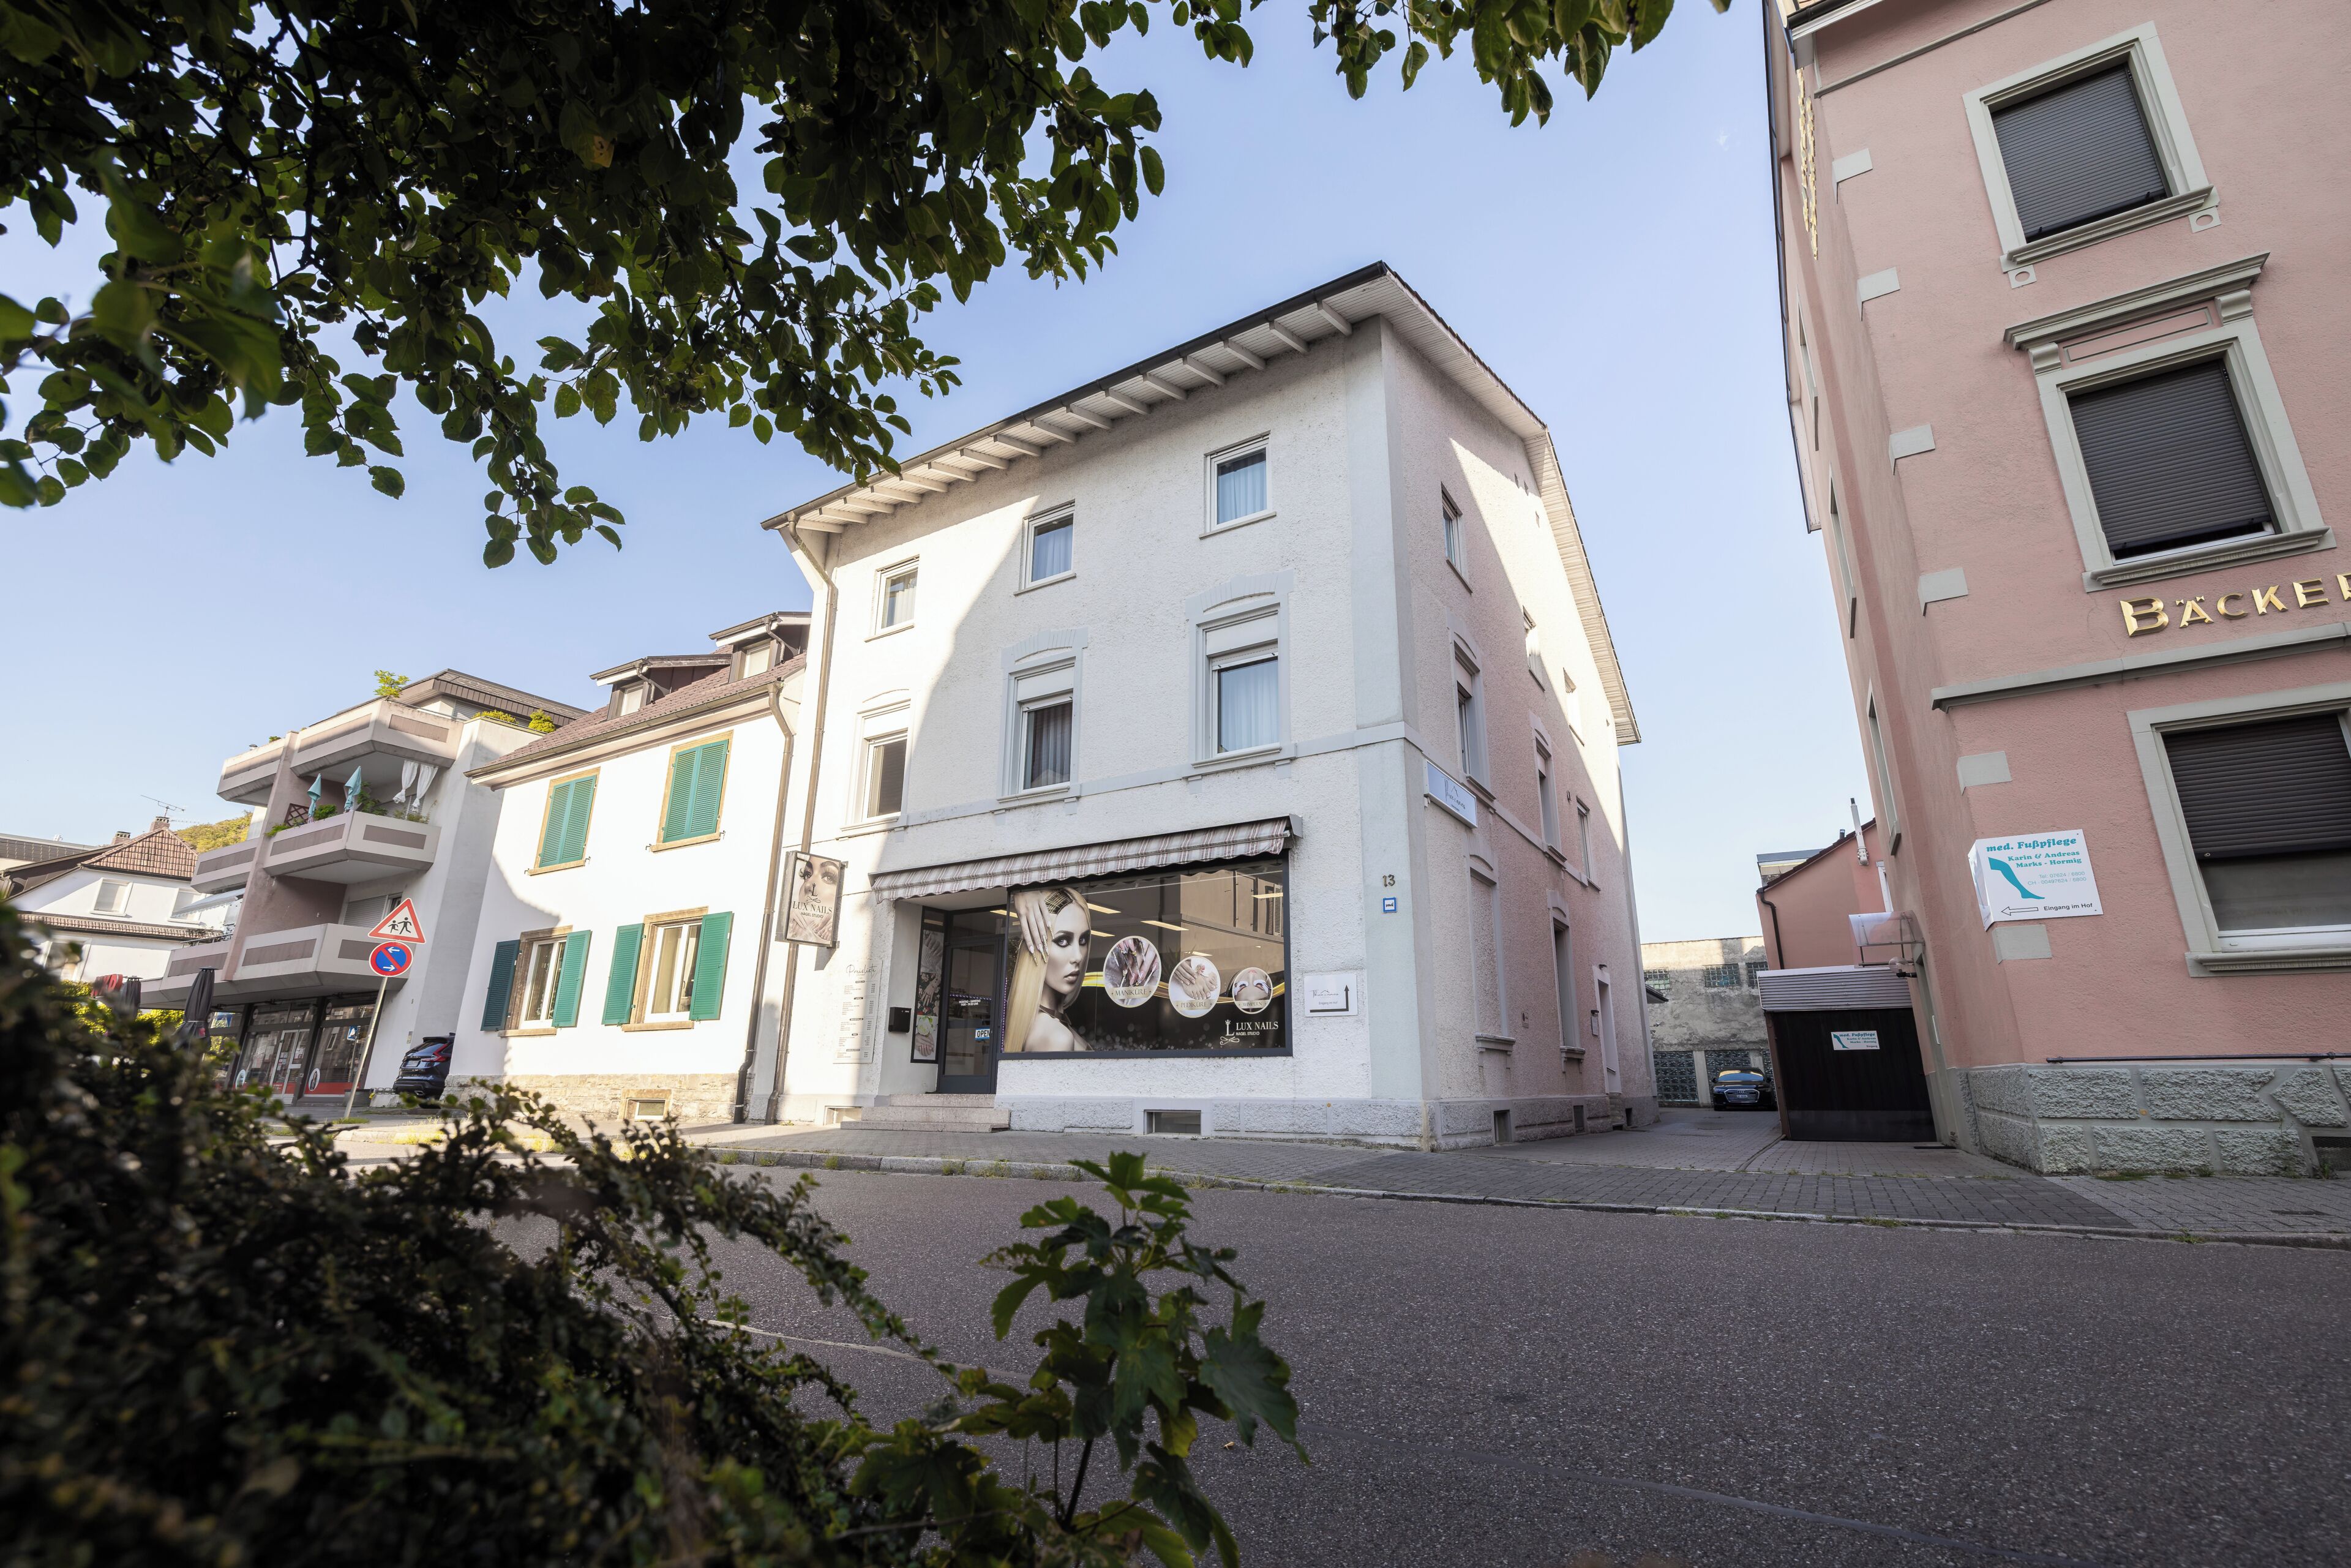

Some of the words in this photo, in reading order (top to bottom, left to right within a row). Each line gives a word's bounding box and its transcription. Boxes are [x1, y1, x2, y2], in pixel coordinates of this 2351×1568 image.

[1986, 842, 2014, 852] med.
[2017, 838, 2077, 849] Fußpflege
[1382, 874, 1395, 887] 13
[793, 901, 808, 911] LUX
[811, 904, 832, 914] NAILS
[846, 963, 877, 978] Preisliste
[1116, 988, 1147, 996] MANIKÜRE
[1236, 1022, 1252, 1030] LUX
[1254, 1021, 1279, 1030] NAILS
